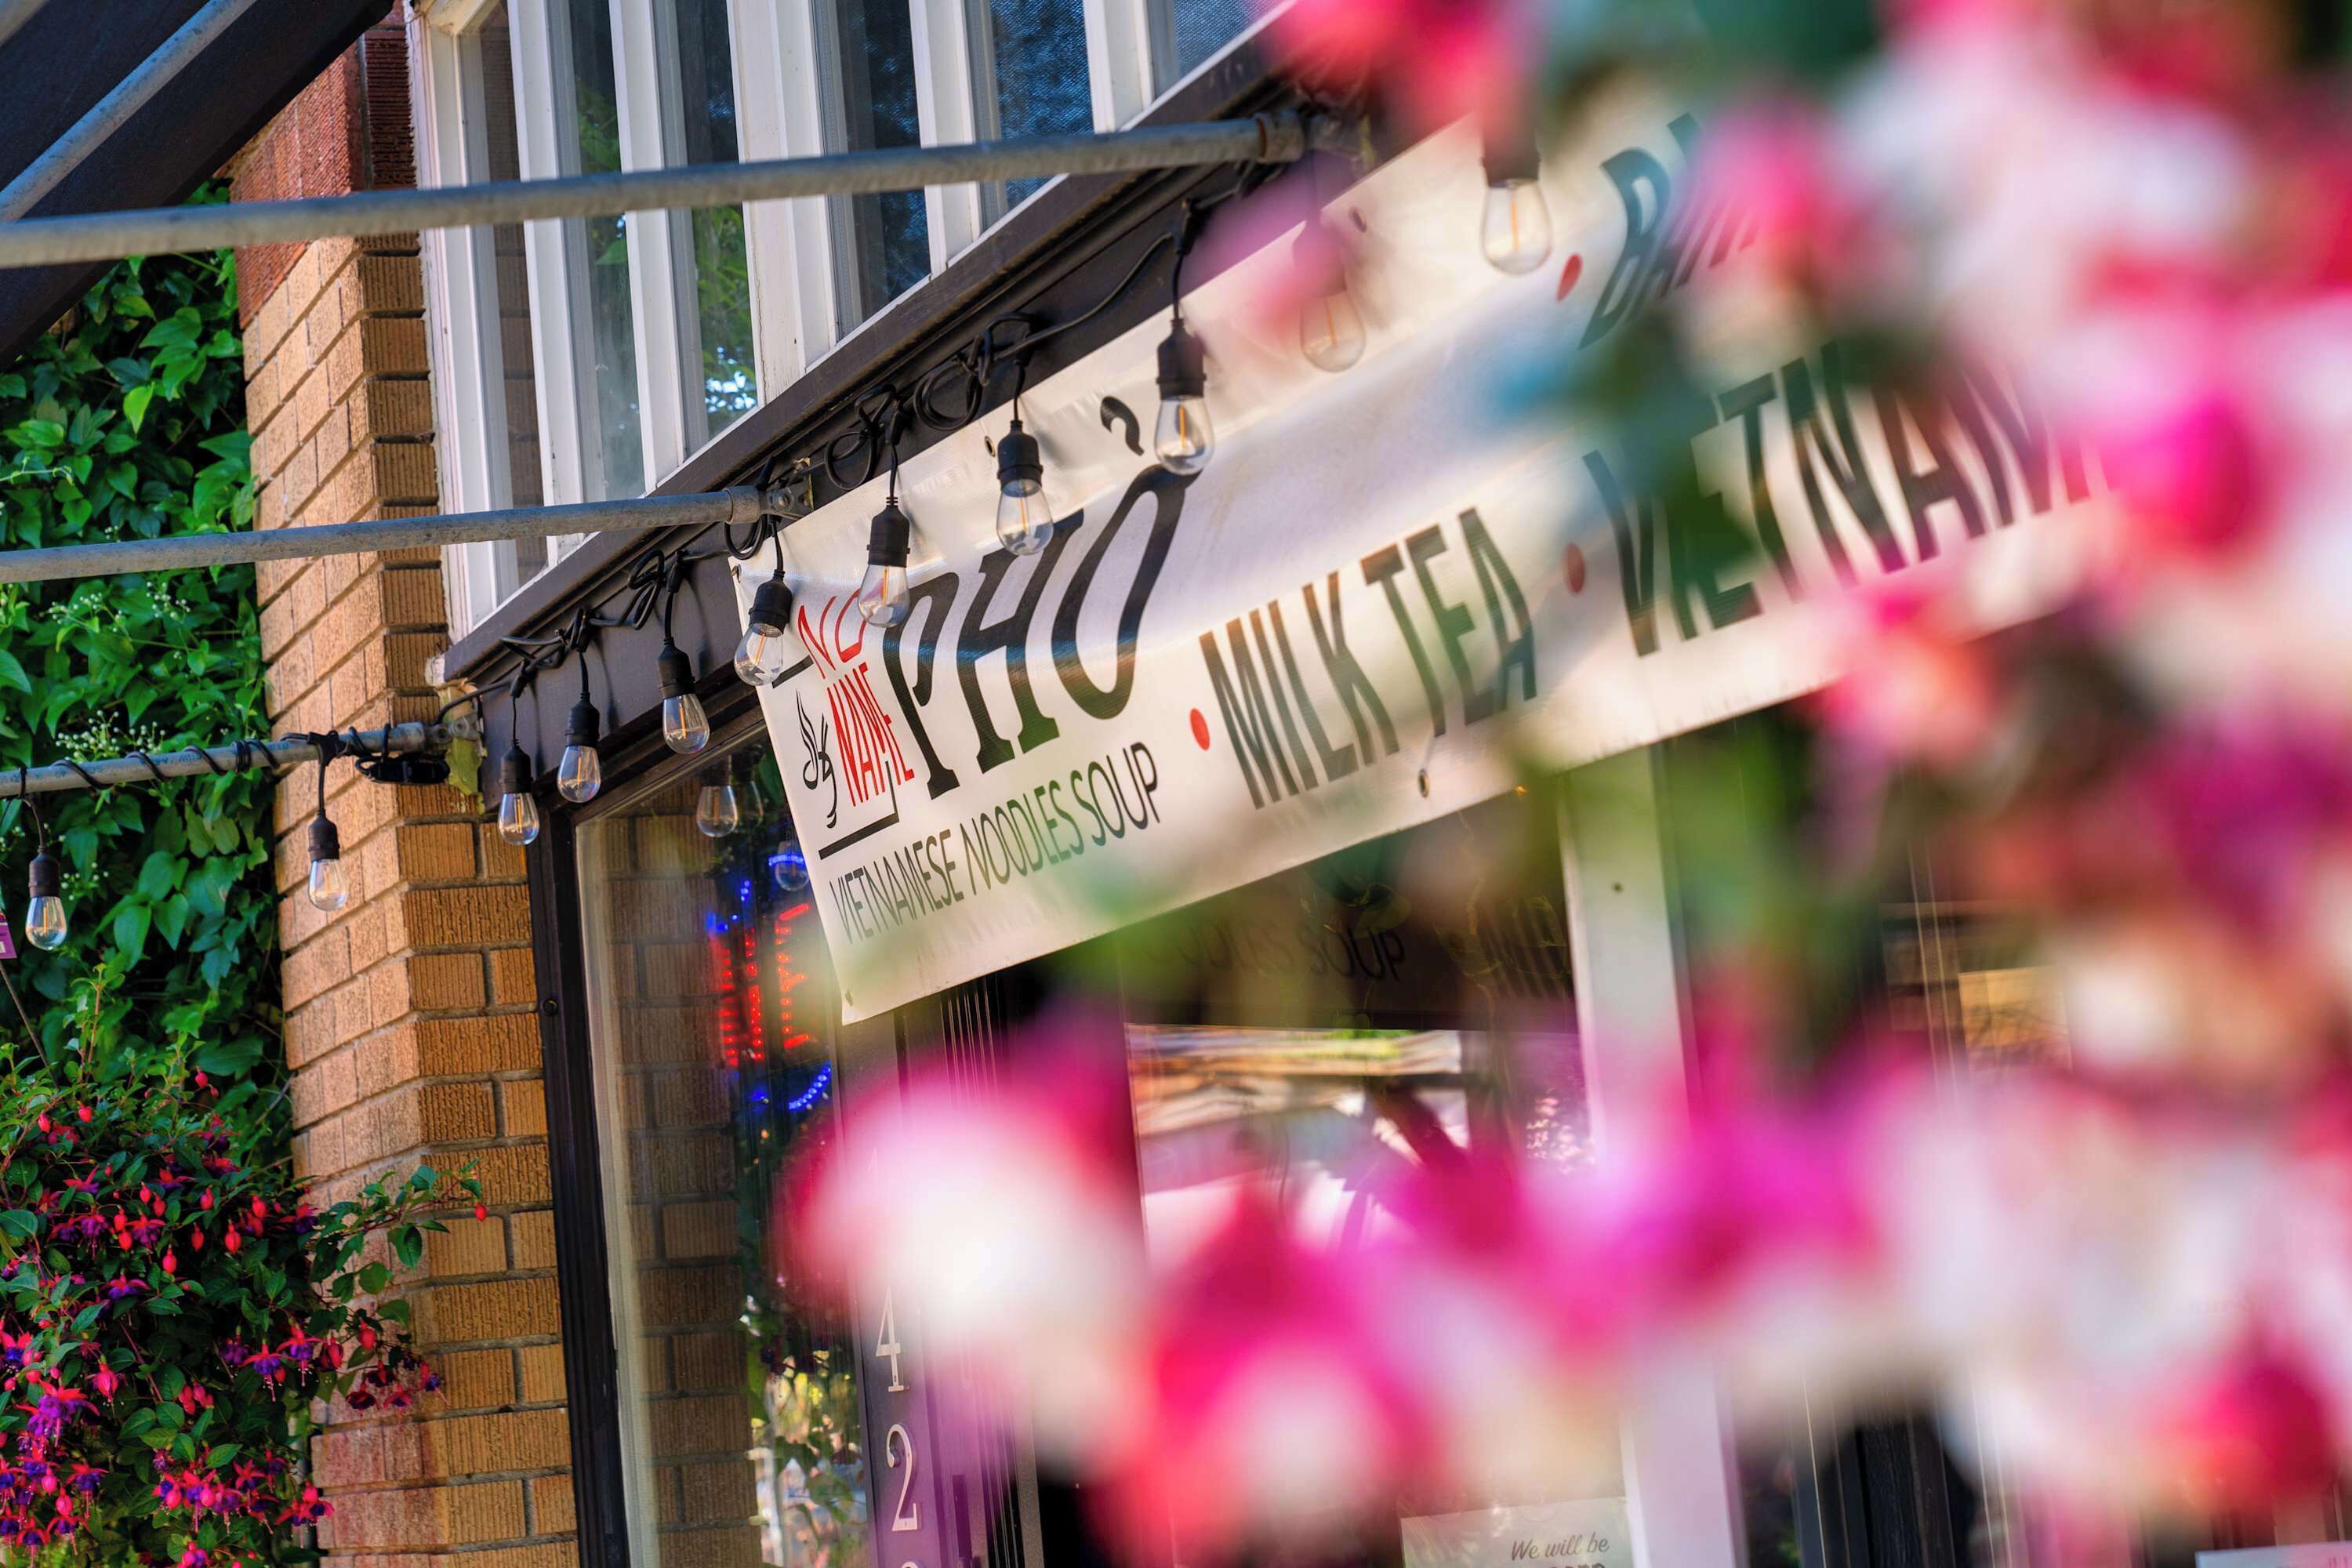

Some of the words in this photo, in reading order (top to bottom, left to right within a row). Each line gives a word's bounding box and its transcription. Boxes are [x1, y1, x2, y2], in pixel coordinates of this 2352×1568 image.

[797, 579, 884, 680] NO
[1199, 570, 1400, 810] MILK
[1360, 506, 1537, 739] TEA
[826, 662, 915, 808] NAME
[829, 829, 964, 946] VIETNAMESE
[959, 779, 1085, 896] NOODLES
[1069, 741, 1161, 847] SOUP
[1510, 1539, 1540, 1561] We
[1544, 1534, 1582, 1559] will
[1586, 1530, 1610, 1554] be
